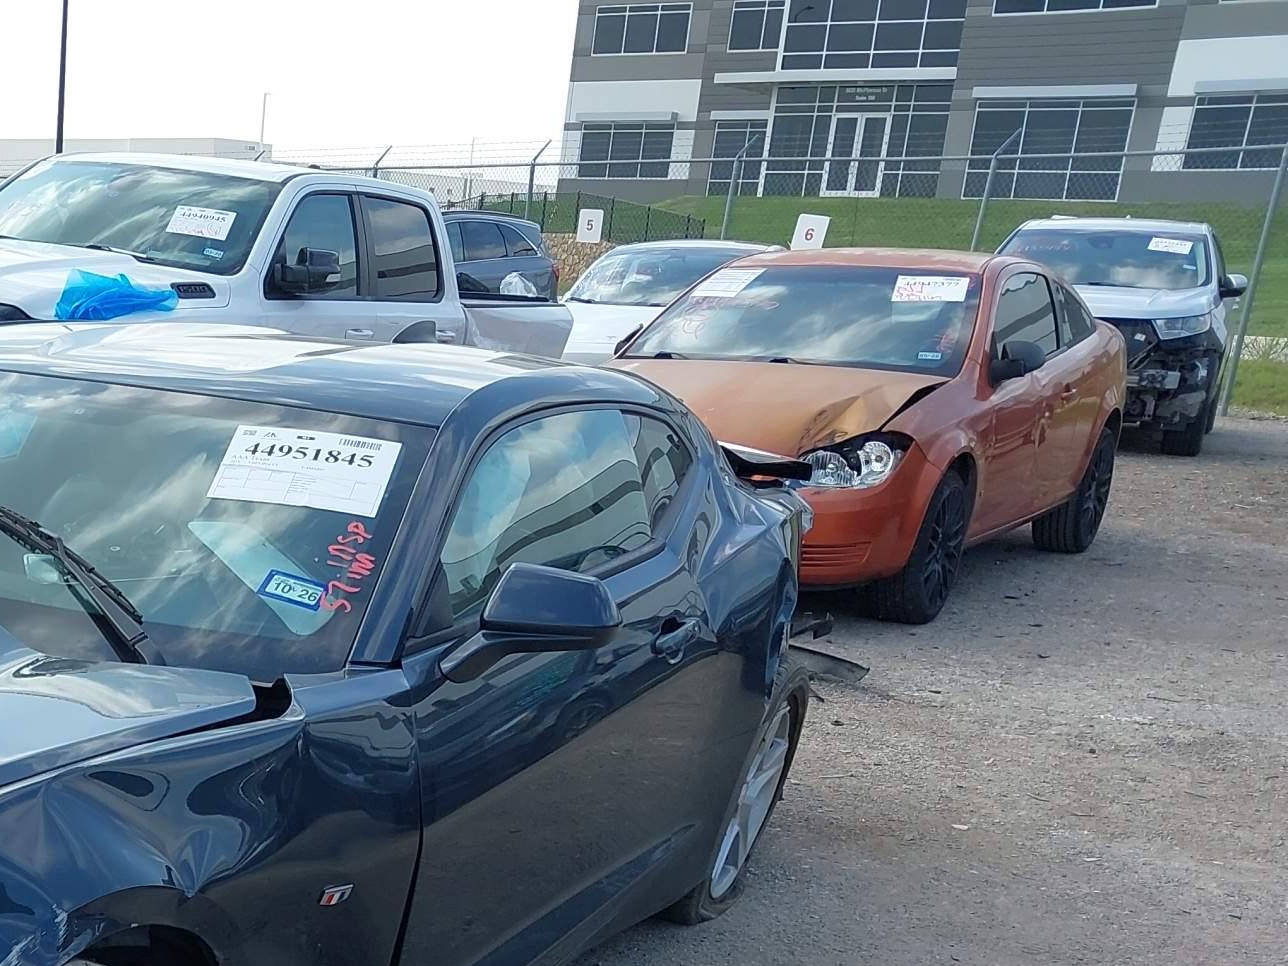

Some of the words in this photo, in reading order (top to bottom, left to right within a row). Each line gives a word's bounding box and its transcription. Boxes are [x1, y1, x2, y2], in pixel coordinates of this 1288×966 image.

[586, 219, 594, 231] 5
[805, 228, 815, 241] 6
[245, 442, 375, 468] 44951845
[274, 581, 292, 595] 10
[297, 588, 319, 602] 26
